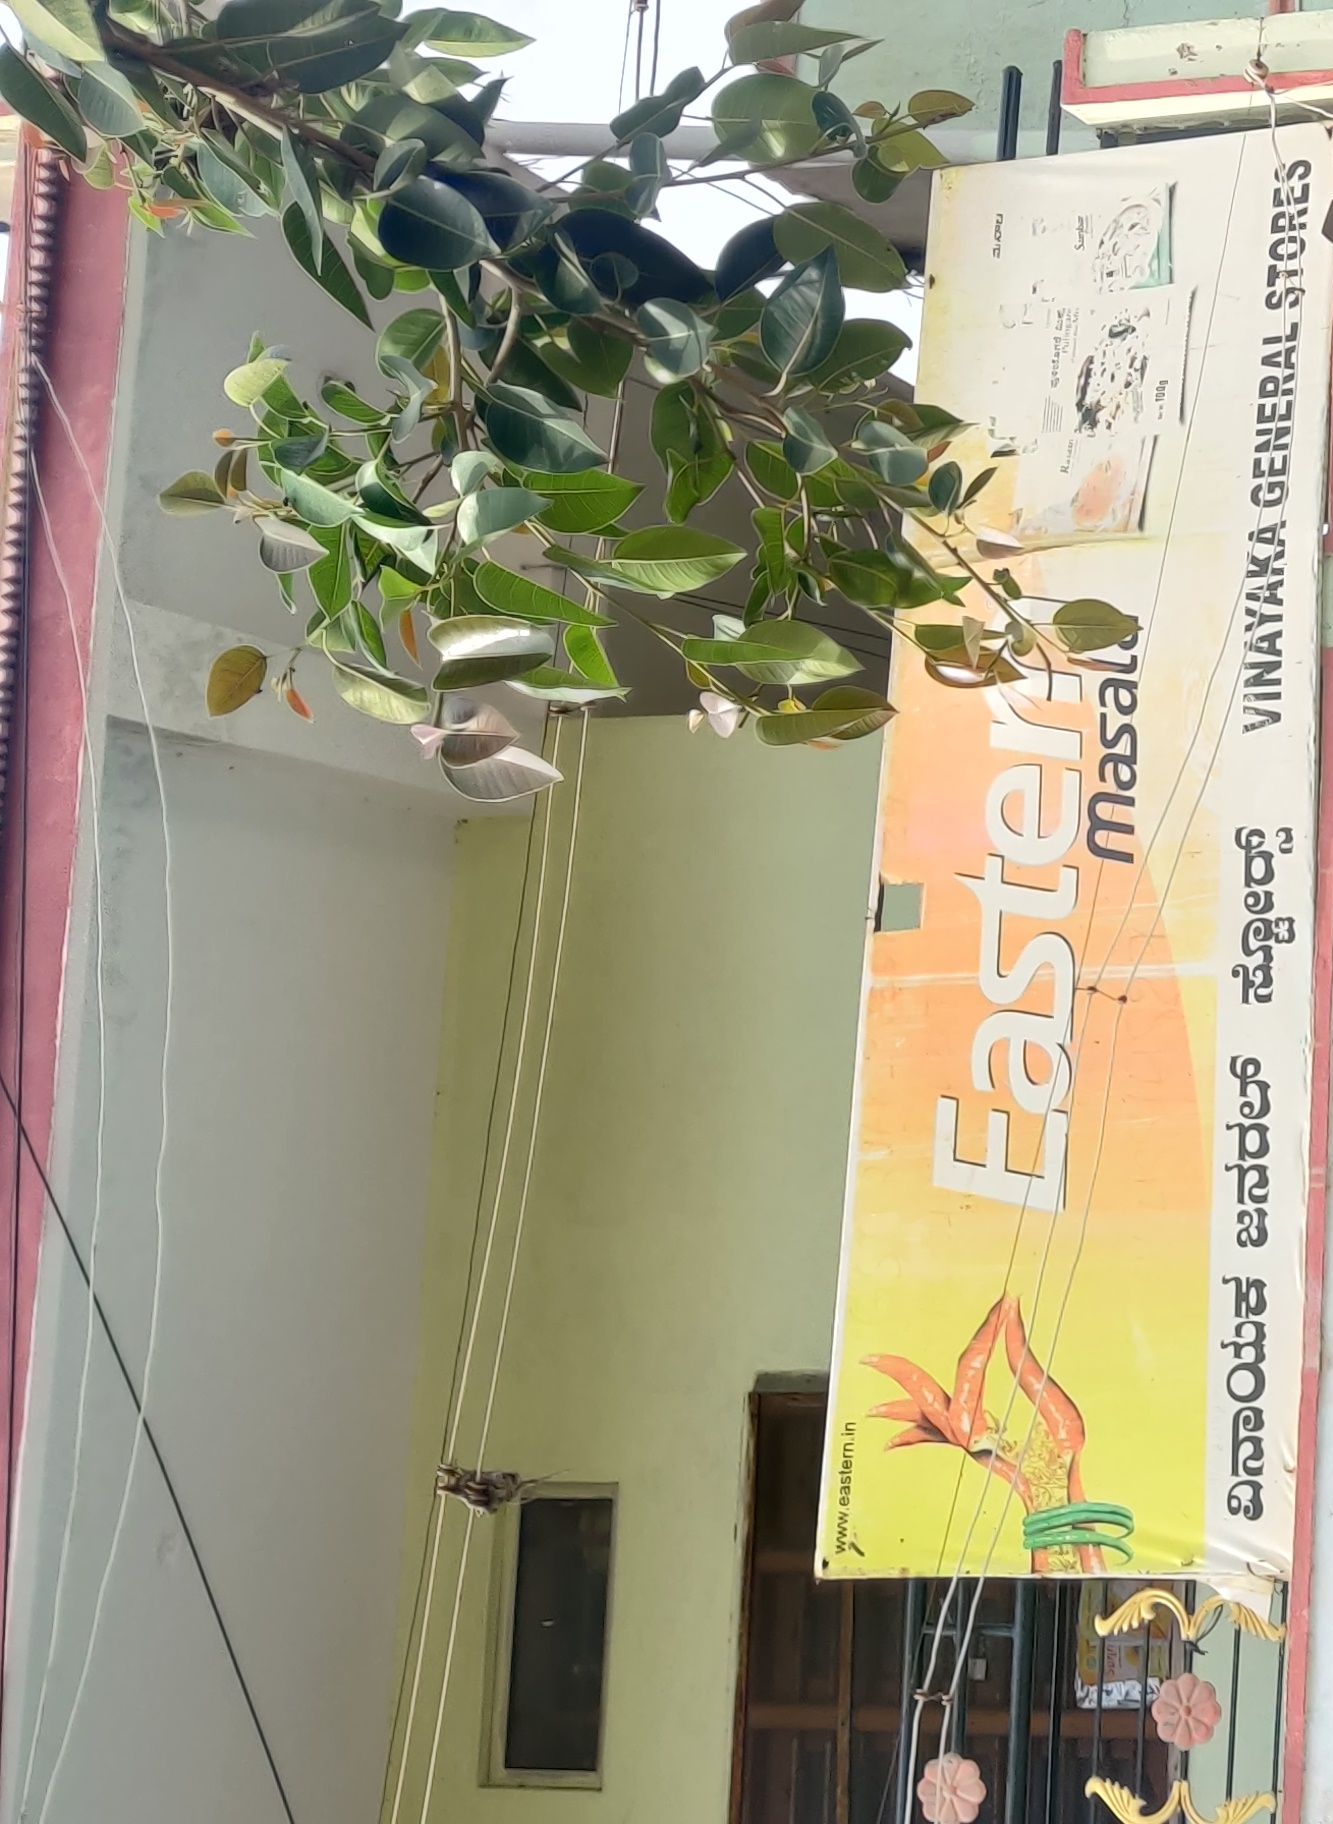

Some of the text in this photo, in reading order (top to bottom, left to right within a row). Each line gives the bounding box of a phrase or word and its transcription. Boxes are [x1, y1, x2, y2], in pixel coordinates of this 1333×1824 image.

[1241, 158, 1313, 734] VINAYAKA GENERAL STORES
[932, 595, 1082, 1213] Eastern
[1220, 825, 1297, 1521] ವಿನಾಯಕ ಜನರಲ್ ಸ್ಟೋರ್ಸ್
[835, 1422, 857, 1554] www.eastern.in
